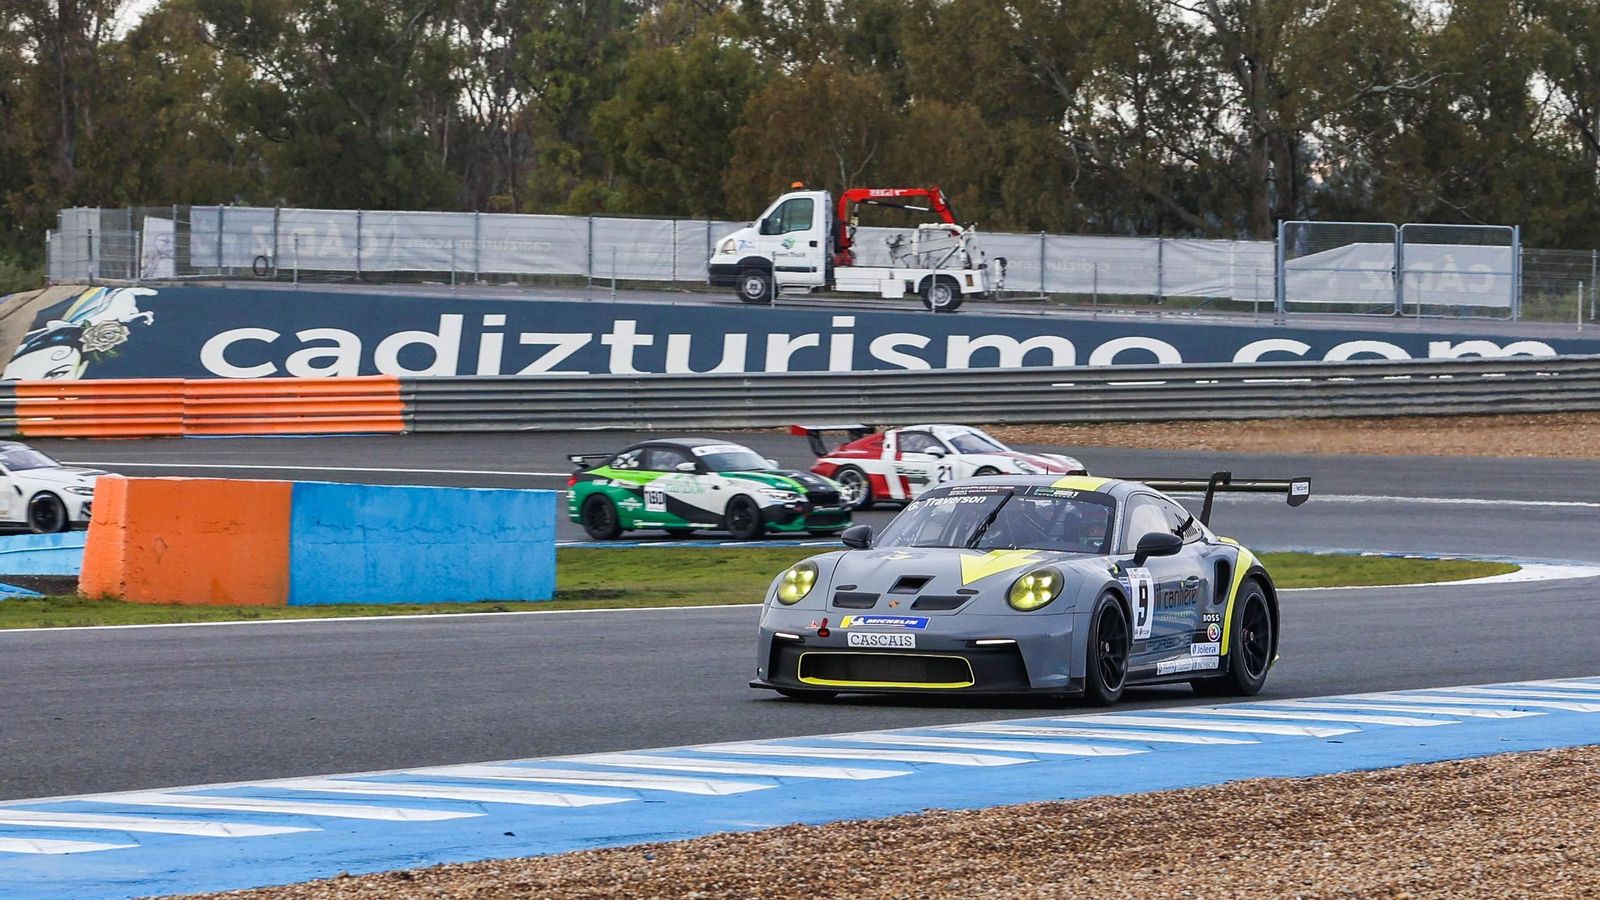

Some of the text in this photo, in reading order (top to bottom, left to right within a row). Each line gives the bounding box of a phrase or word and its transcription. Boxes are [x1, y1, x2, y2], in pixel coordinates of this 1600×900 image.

[200, 314, 1558, 383] cadizturismocom
[938, 466, 953, 482] 21
[924, 496, 987, 506] Traverson
[1137, 580, 1148, 627] 9
[1203, 614, 1220, 622] BOSS
[850, 634, 912, 647] CASCAIS
[1197, 645, 1216, 654] Jolera
